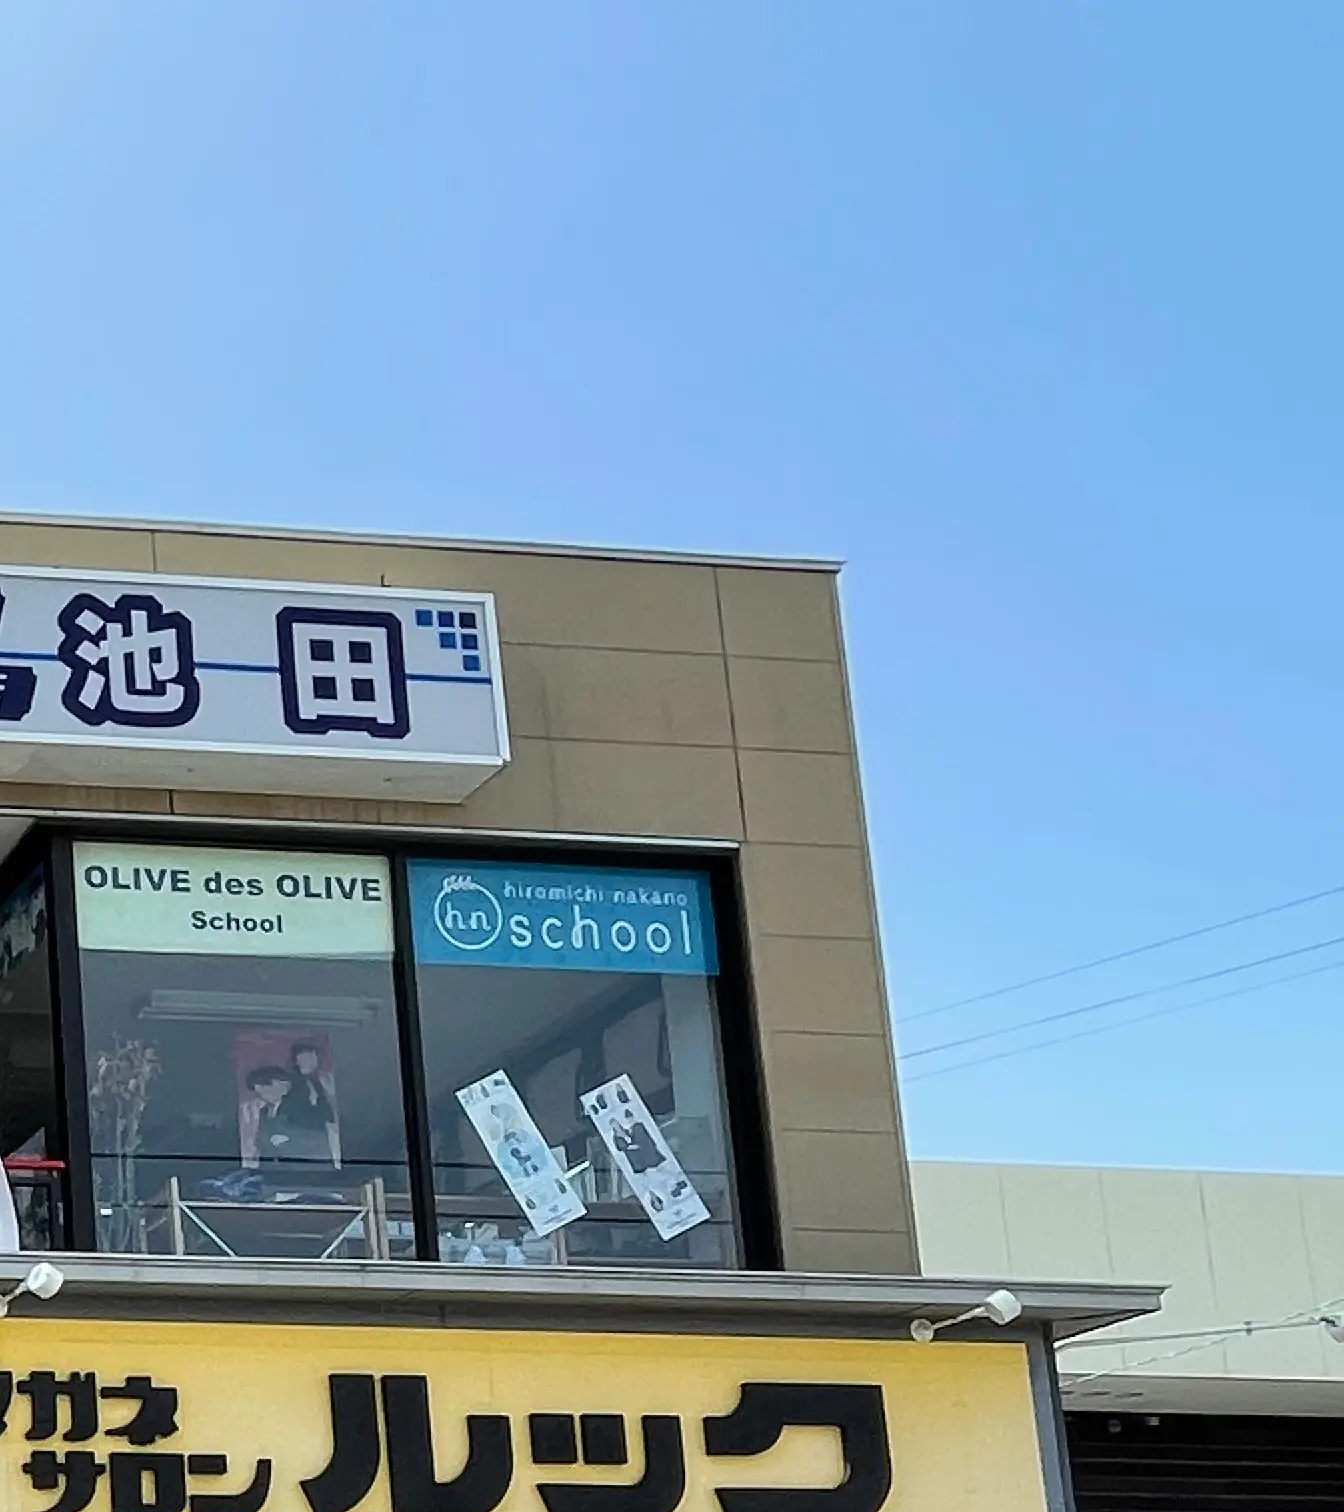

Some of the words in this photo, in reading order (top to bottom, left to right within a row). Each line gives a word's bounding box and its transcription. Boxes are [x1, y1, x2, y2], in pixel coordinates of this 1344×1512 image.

[57, 593, 410, 739] 池田
[83, 865, 192, 893] OLIVE
[203, 871, 265, 897] des
[276, 874, 382, 901] OLIVE
[503, 880, 604, 903] hiromichi
[613, 887, 689, 907] nakano
[190, 910, 285, 934] School
[510, 904, 693, 956] school
